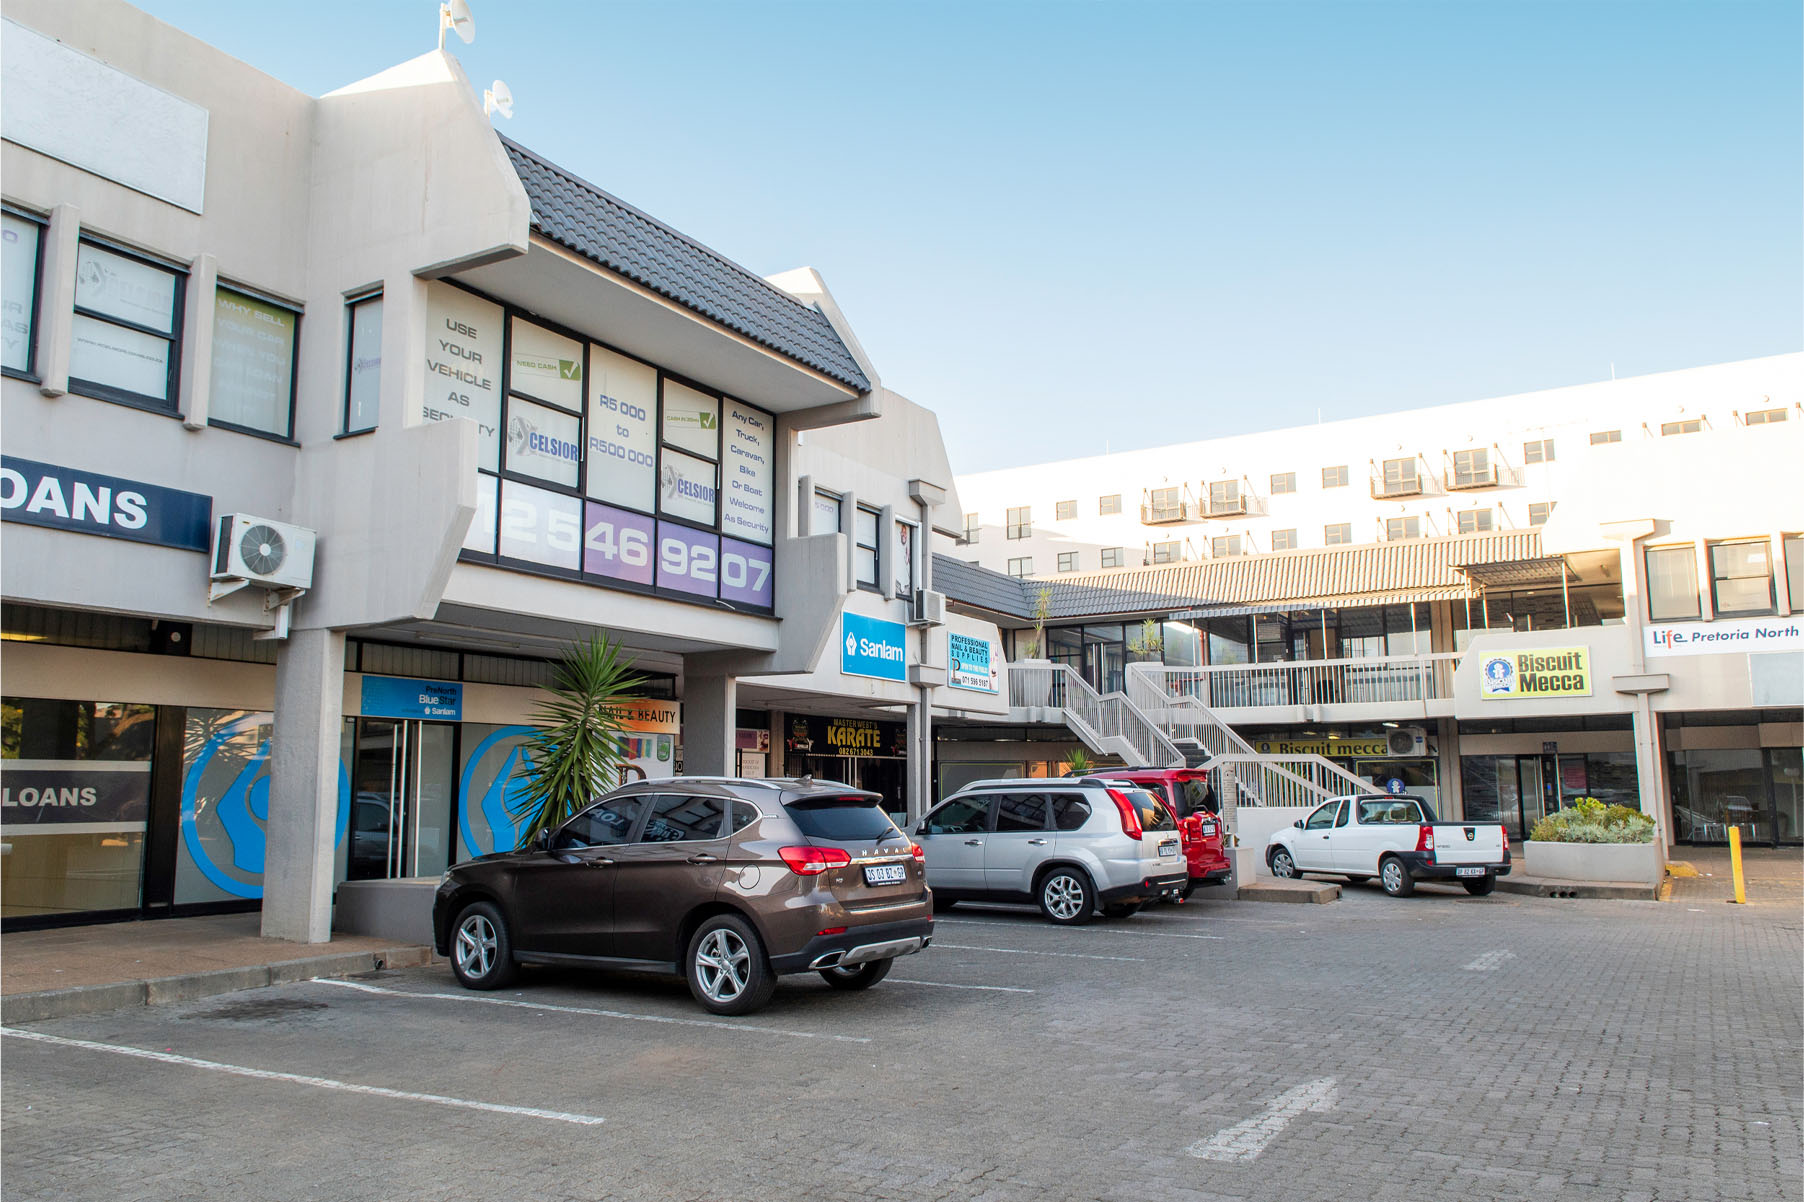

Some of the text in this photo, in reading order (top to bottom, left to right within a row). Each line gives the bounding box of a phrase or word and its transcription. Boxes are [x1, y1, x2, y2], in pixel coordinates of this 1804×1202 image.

[254, 310, 286, 328] SELL
[446, 318, 477, 340] USE
[438, 338, 482, 365] YOUR
[427, 358, 491, 391] VEHICLE
[448, 391, 470, 407] AS
[600, 394, 646, 421] R5 000
[732, 411, 765, 431] Any Car,
[616, 424, 629, 438] to
[736, 429, 761, 446] Truck,
[590, 436, 654, 467] R500 000
[730, 444, 766, 465] Caravan,
[739, 465, 757, 478] Bike
[731, 480, 763, 497] Or Boat
[729, 496, 765, 514] Welcome
[724, 514, 769, 534] As Security
[951, 634, 988, 650] PROFESSIONAL
[1653, 625, 1800, 649] Life Pretoria North
[860, 638, 904, 662] Sanlam
[951, 643, 963, 651] NAIL
[969, 647, 988, 656] BEAUTY
[951, 650, 988, 663] SUPPLIES
[1517, 652, 1583, 672] Biscuit
[425, 686, 457, 695] PreNorth
[1519, 673, 1585, 692] Mecca
[431, 707, 456, 716] Sanlam
[637, 709, 676, 723] BEAUTY
[833, 718, 857, 728] MASTER
[827, 725, 881, 748] KARATE
[1279, 741, 1388, 755] Biscuit mecca
[0, 787, 97, 806] LOANS
[862, 848, 906, 856] HAVAL
